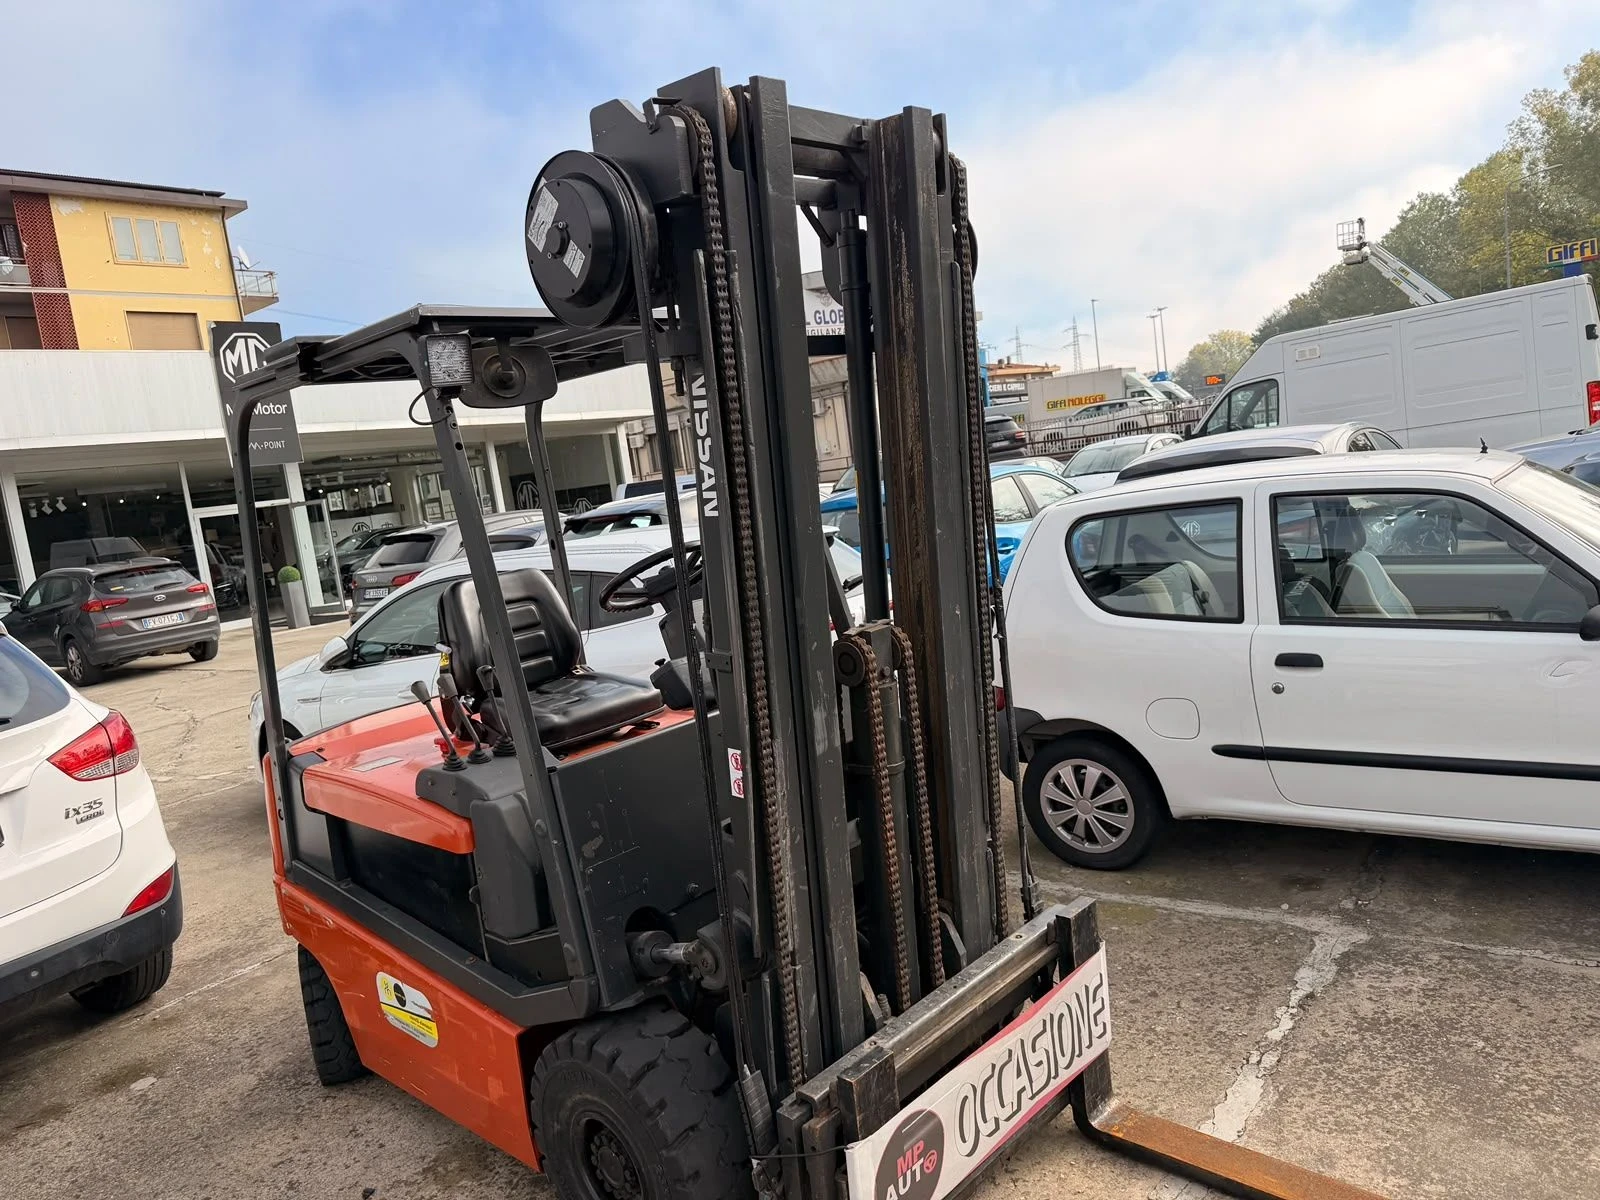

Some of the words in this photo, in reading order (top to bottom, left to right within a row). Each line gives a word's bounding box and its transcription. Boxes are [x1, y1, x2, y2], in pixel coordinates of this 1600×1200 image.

[692, 374, 719, 517] NISSAN
[64, 797, 103, 820] ix35
[953, 971, 1108, 1157] OCCASIONE
[896, 1140, 925, 1178] MP
